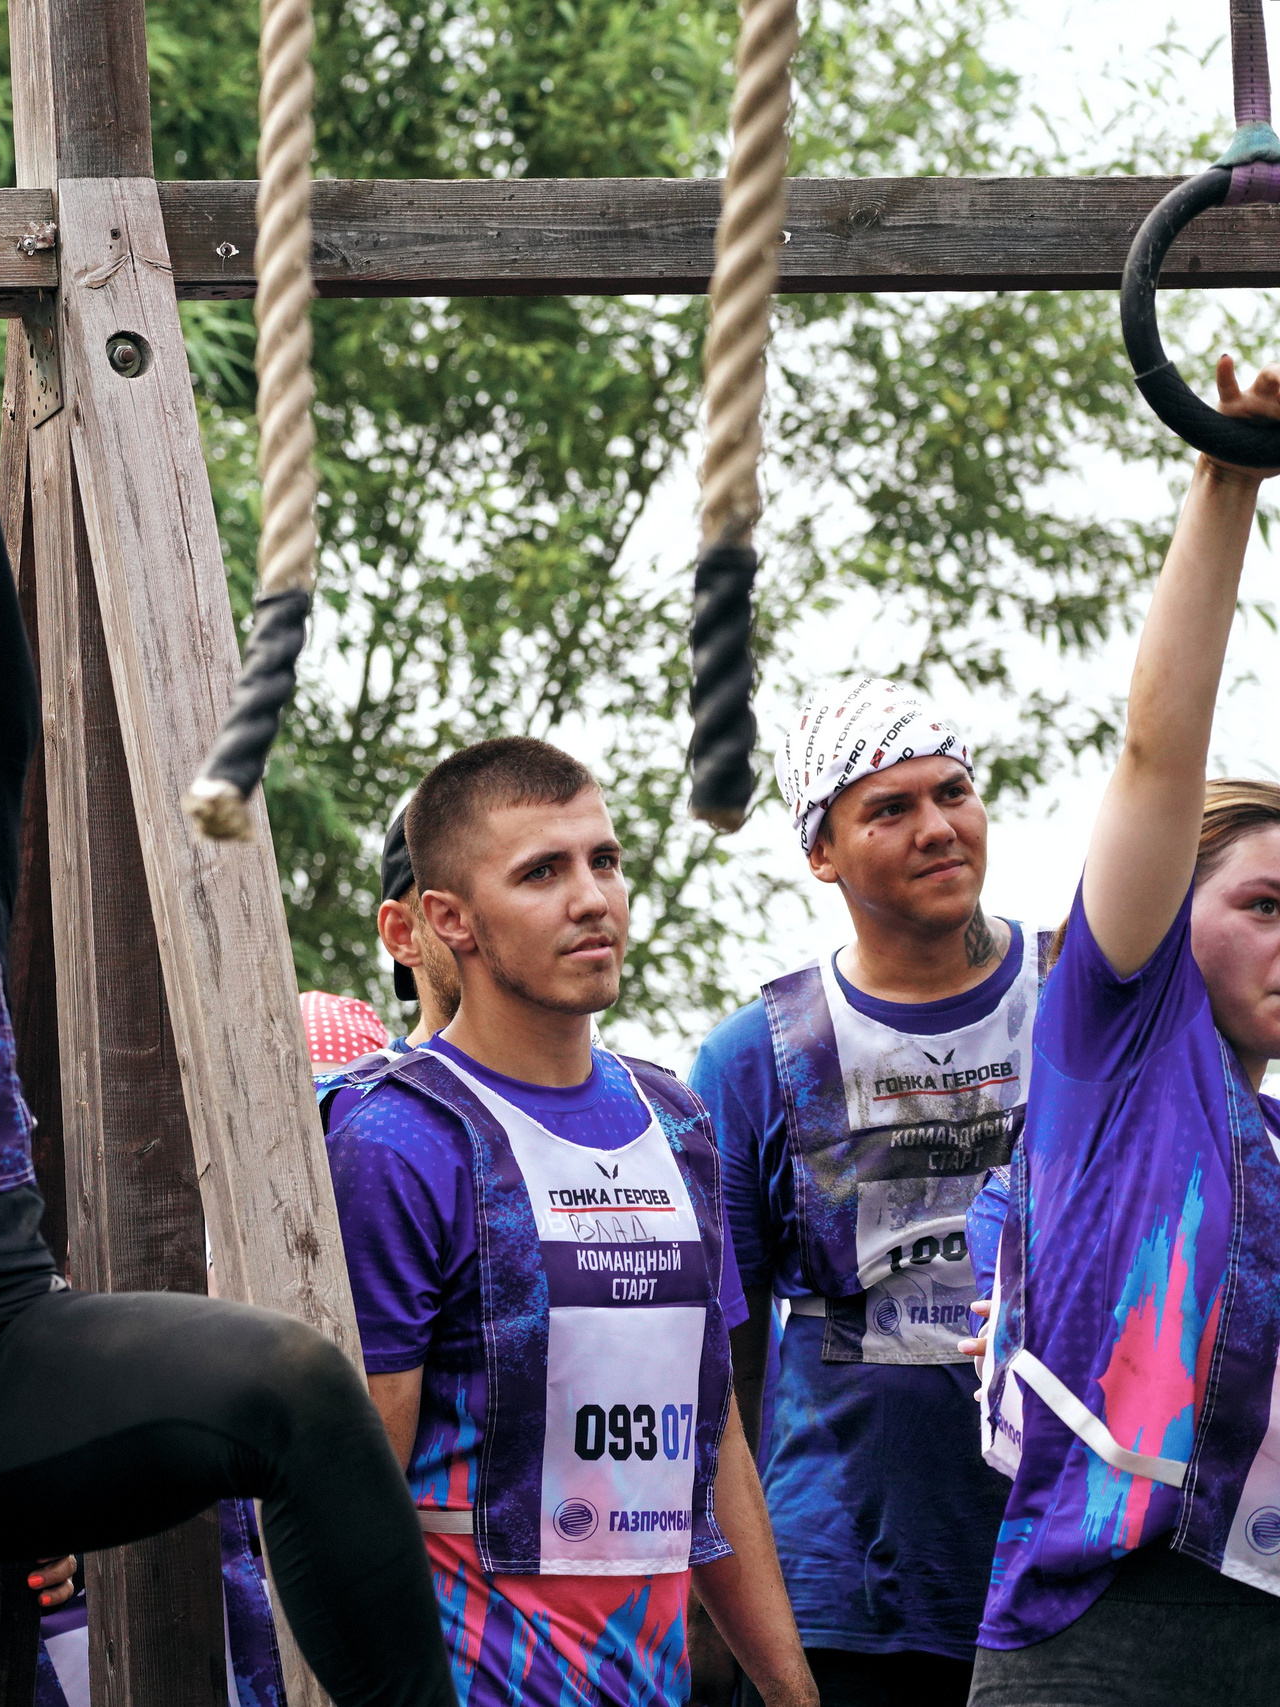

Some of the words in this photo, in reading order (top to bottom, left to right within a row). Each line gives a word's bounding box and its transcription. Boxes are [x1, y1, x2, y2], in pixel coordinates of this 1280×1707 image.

[805, 705, 829, 768] TORERO
[874, 1075, 938, 1095] ГОНКА
[941, 1061, 1014, 1089] ГЕРОЕВ
[890, 1109, 1015, 1149] КОМАНДНЫЙ
[548, 1188, 612, 1206] ГОНКА
[614, 1188, 671, 1206] ГЕРОЕВ
[576, 1242, 682, 1276] КОМАНДНЫЙ
[612, 1278, 658, 1301] СТАРТ
[574, 1403, 693, 1461] 09307
